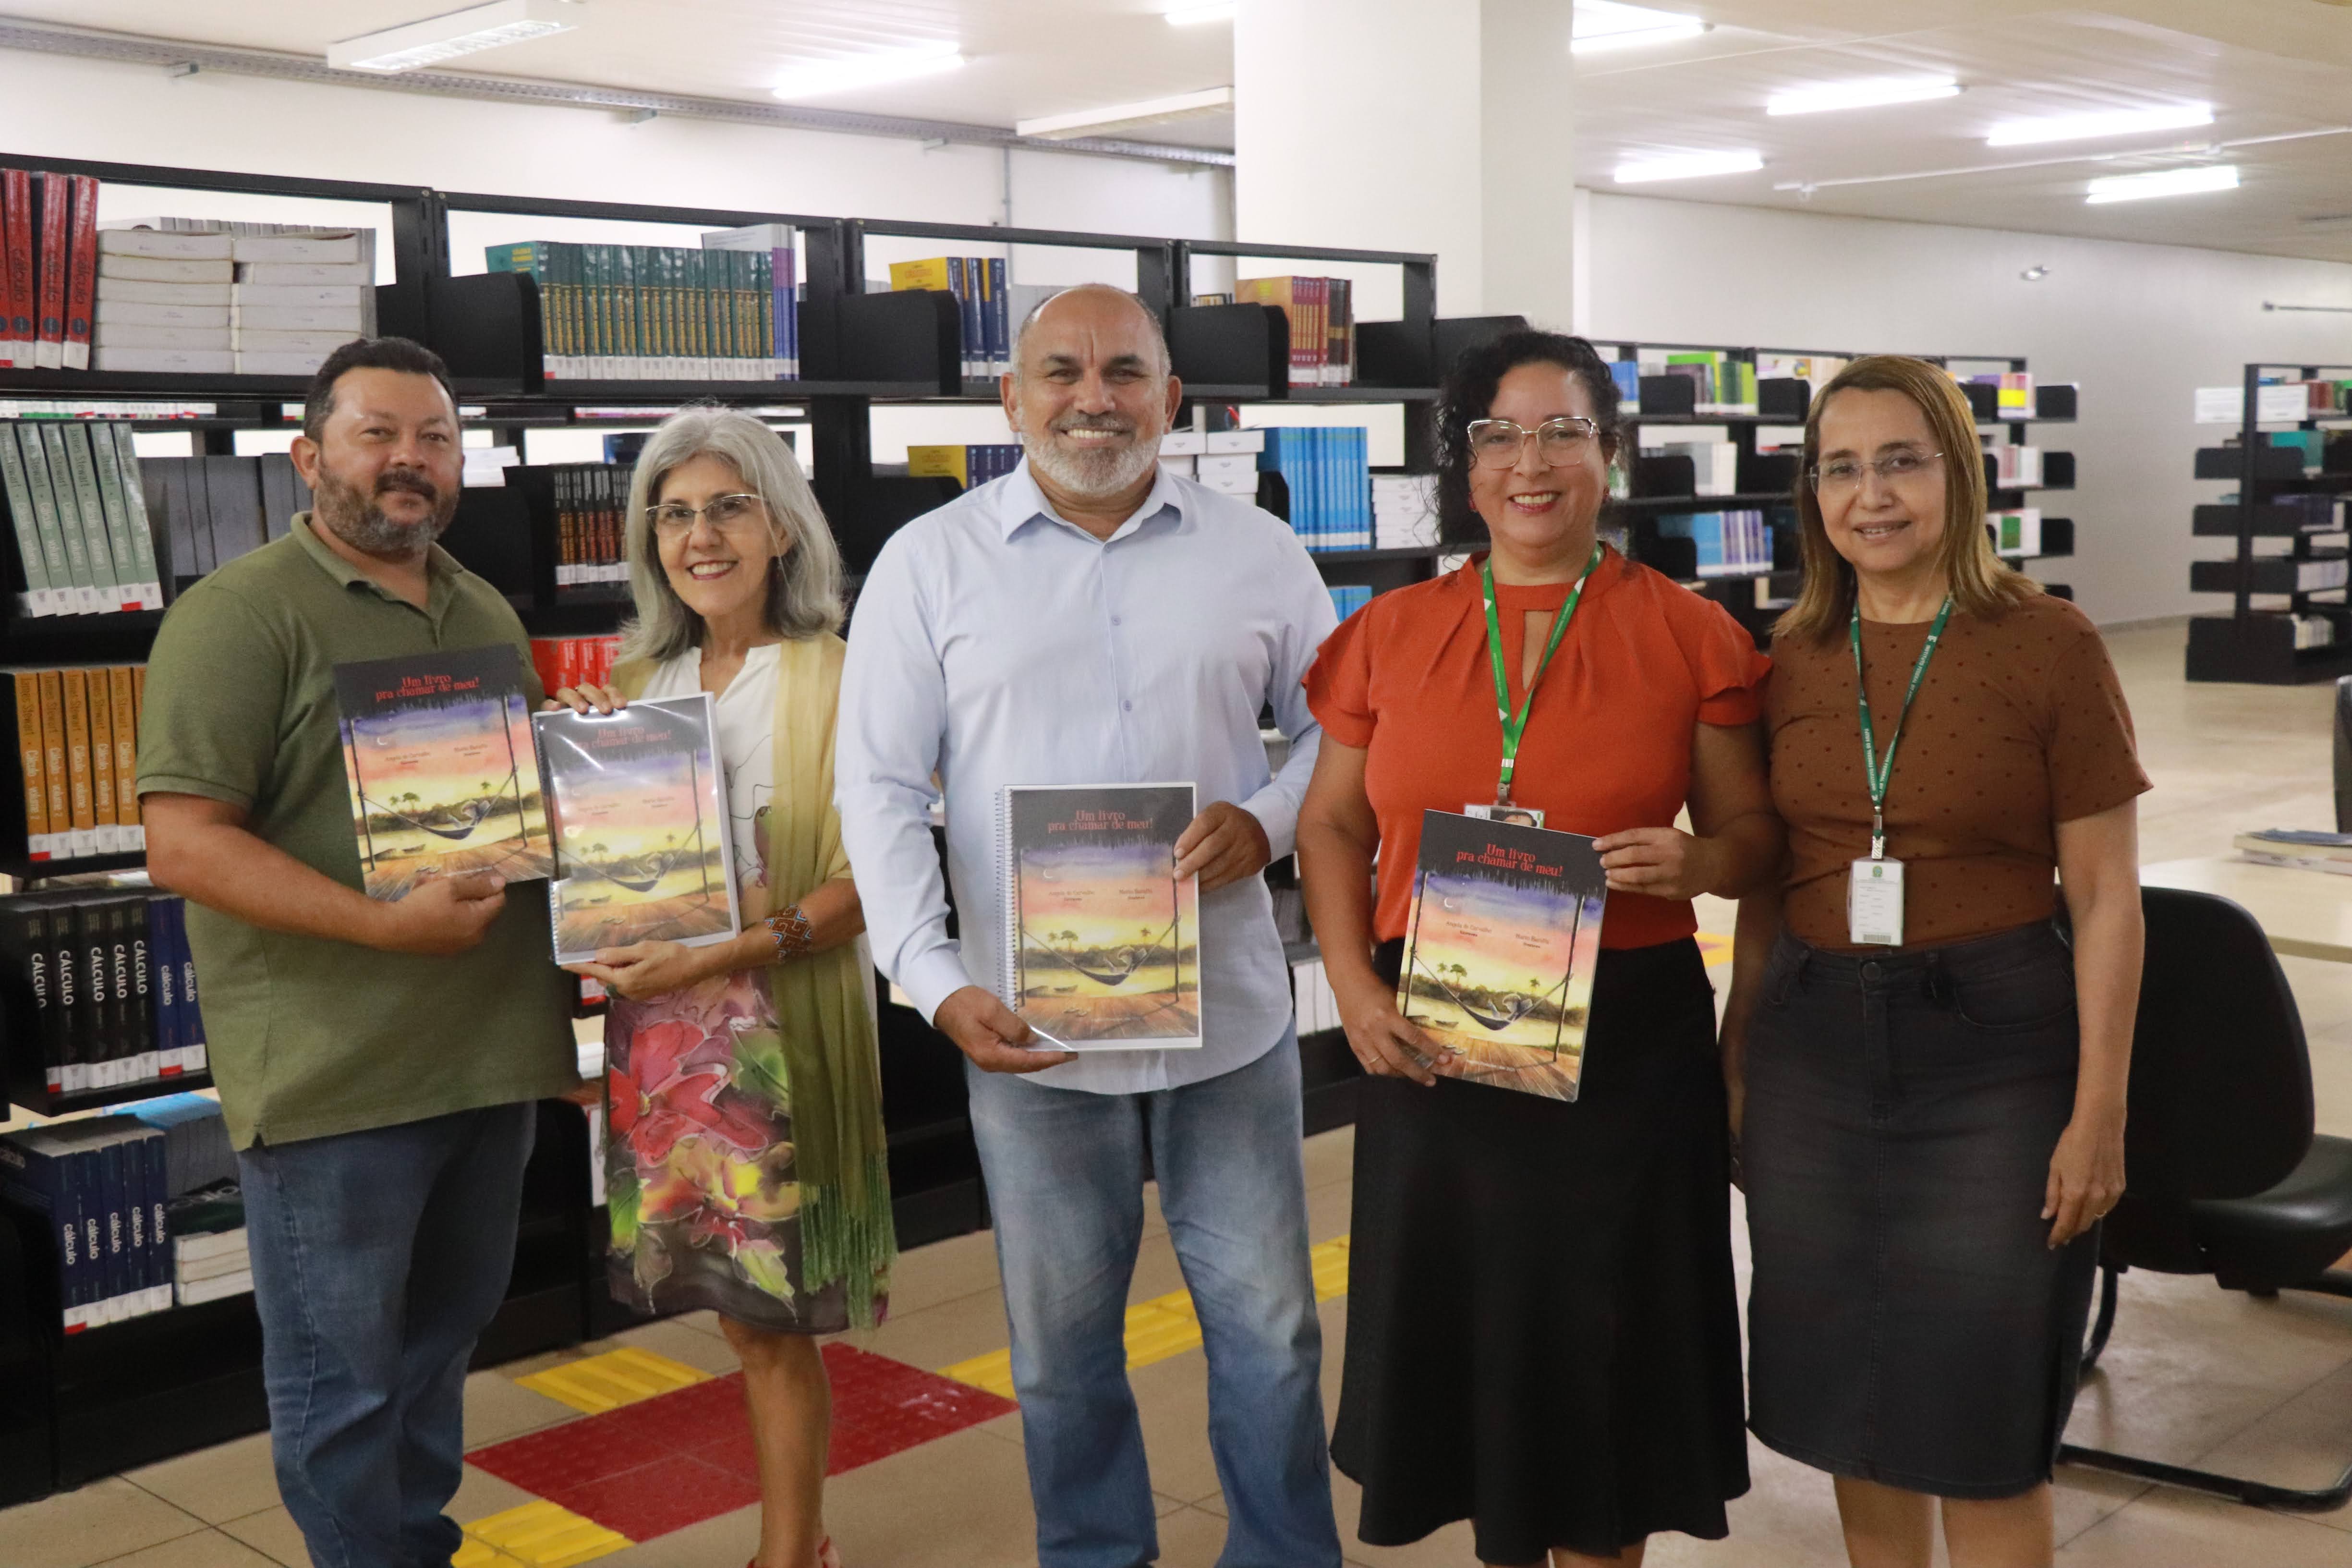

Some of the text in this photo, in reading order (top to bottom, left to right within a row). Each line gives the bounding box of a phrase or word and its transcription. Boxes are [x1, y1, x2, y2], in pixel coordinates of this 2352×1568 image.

[69, 429, 84, 454] James
[75, 456, 90, 487] Stewart
[376, 677, 479, 702] pra chamar de meu!
[401, 675, 451, 687] Um livro
[1047, 818, 1153, 834] pra chamar de meu!
[1076, 809, 1126, 821] Um livro
[1456, 851, 1564, 877] pra chamar de meu!
[1486, 843, 1536, 863] Um livro
[59, 950, 74, 1005] CÁLCULO
[91, 947, 105, 1002] CÁLCULO
[114, 945, 127, 998] CÁLCULO
[133, 940, 147, 994] CÁLCULO
[161, 965, 173, 1005] cálculo
[184, 962, 196, 1002] cálculo
[87, 1218, 100, 1260] cálculo
[110, 1213, 122, 1253] cálculo
[132, 1207, 144, 1247] cálculo
[154, 1203, 166, 1245] cálculo
[63, 1224, 77, 1265] cálculo
